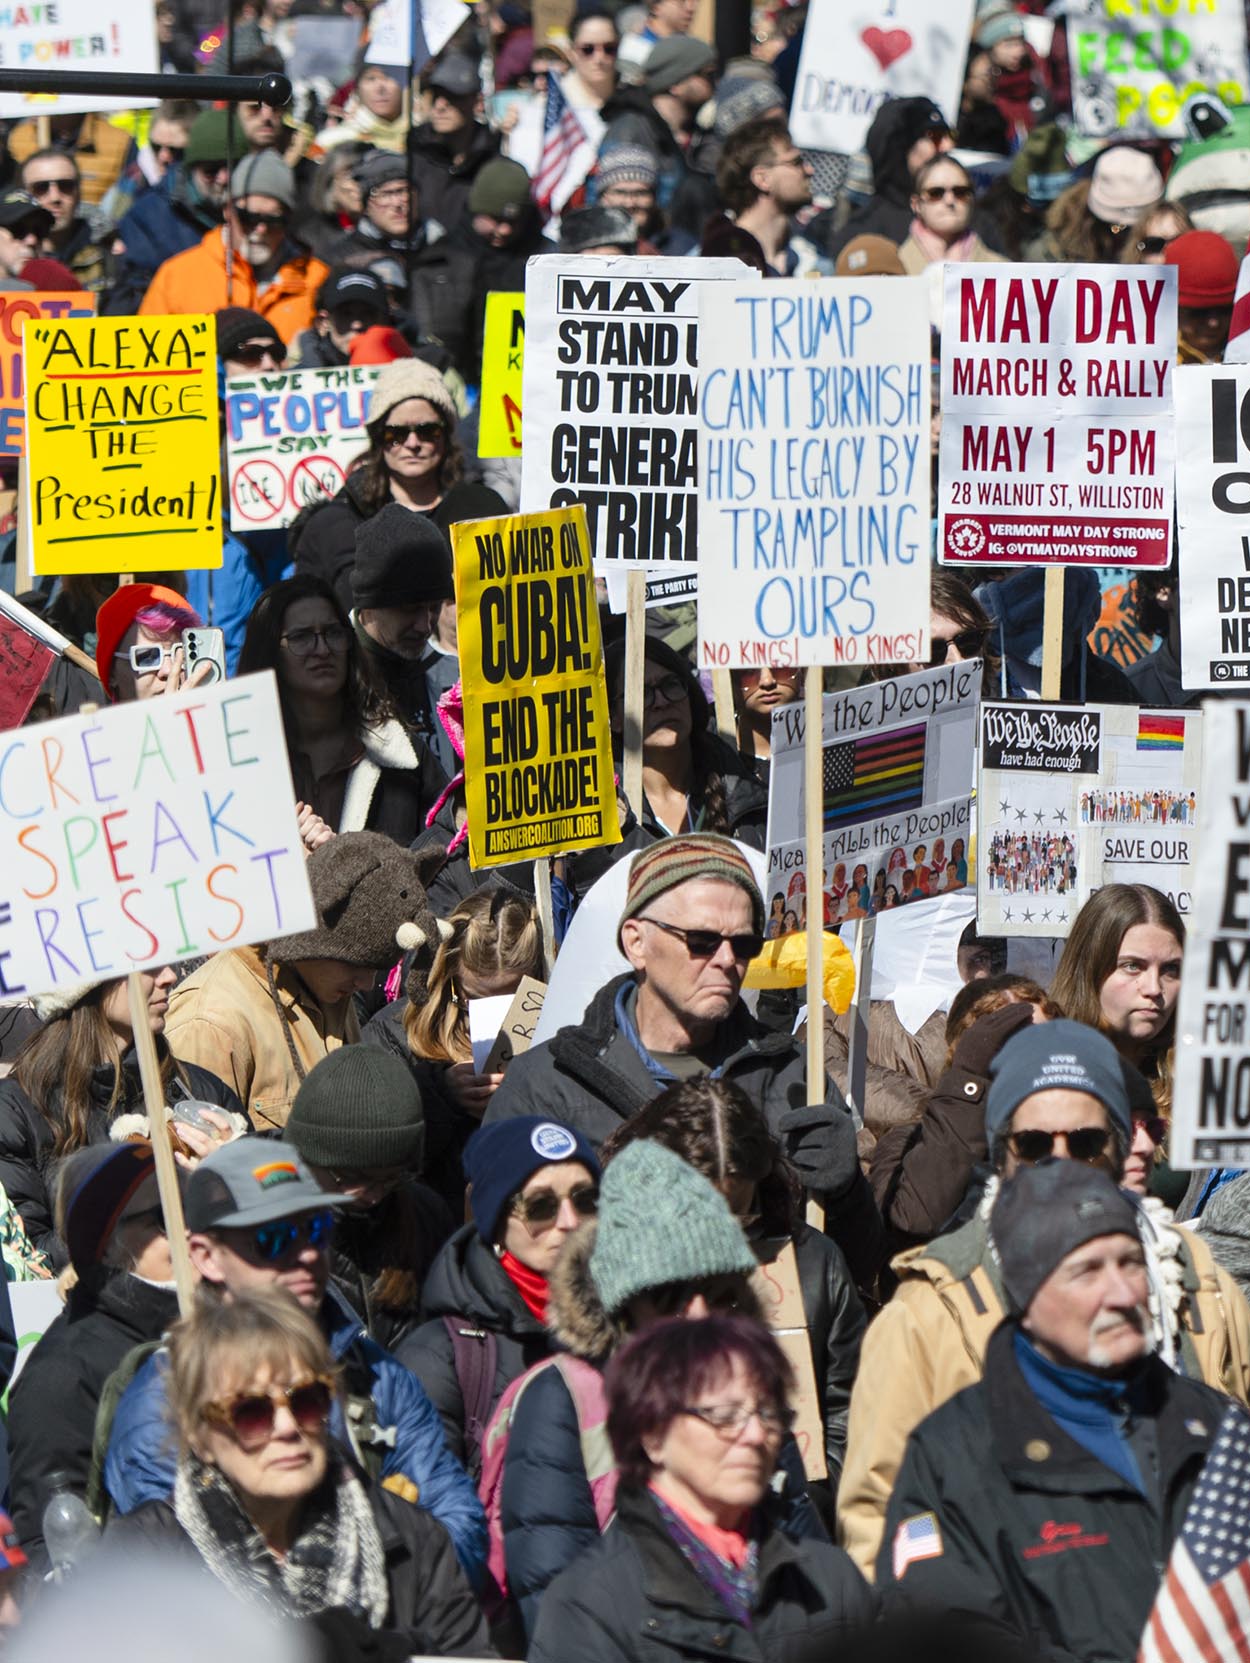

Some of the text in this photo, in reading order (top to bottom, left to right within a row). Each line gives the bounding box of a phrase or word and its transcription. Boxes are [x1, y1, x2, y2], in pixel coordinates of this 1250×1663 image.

[19, 20, 120, 63] POWER!
[1077, 28, 1192, 78] FEED
[562, 279, 691, 313] MAY
[959, 278, 1166, 345] MAY DAY
[557, 320, 678, 367] STAND
[735, 296, 872, 359] TRUMP
[261, 368, 363, 391] WE THE
[557, 371, 600, 414] TO
[702, 364, 921, 430] CAN'T BURNISH
[952, 357, 1169, 398] MARCH & RALLY
[34, 381, 204, 423] CHANGE
[83, 430, 158, 460] THE
[277, 436, 333, 454] SAY
[706, 434, 920, 500] HIS LEGACY BY
[961, 425, 1155, 475] MAY 1 5PM
[36, 475, 217, 532] President!
[951, 481, 1164, 511] 28 WALNUT ST, WILLISTON
[475, 521, 583, 580] NO WAR ON
[720, 503, 919, 570] TRAMPLING
[989, 524, 1165, 540] VERMONT MAY DAY STRONG
[1006, 543, 1138, 558] @VTMAYDAYSTRONG
[755, 570, 875, 638] OURS
[479, 573, 592, 684] CUBA!
[834, 629, 924, 663] NO KINGS!
[702, 637, 800, 668] NO KINGS!
[1233, 665, 1248, 677] THE
[482, 685, 596, 767] END THE
[833, 695, 873, 733] the
[984, 709, 1017, 748] We
[1037, 711, 1100, 758] People
[0, 694, 260, 818] CREATE
[1000, 750, 1081, 772] have had enough
[485, 755, 599, 825] BLOCKADE!
[18, 790, 256, 899] SPEAK
[489, 815, 600, 854] ANSWERCOALITION.ORG
[831, 799, 971, 860] ALL the People!
[1104, 838, 1189, 860] SAVE OUR
[34, 848, 289, 982] RESIST
[1202, 1003, 1247, 1045] FOR
